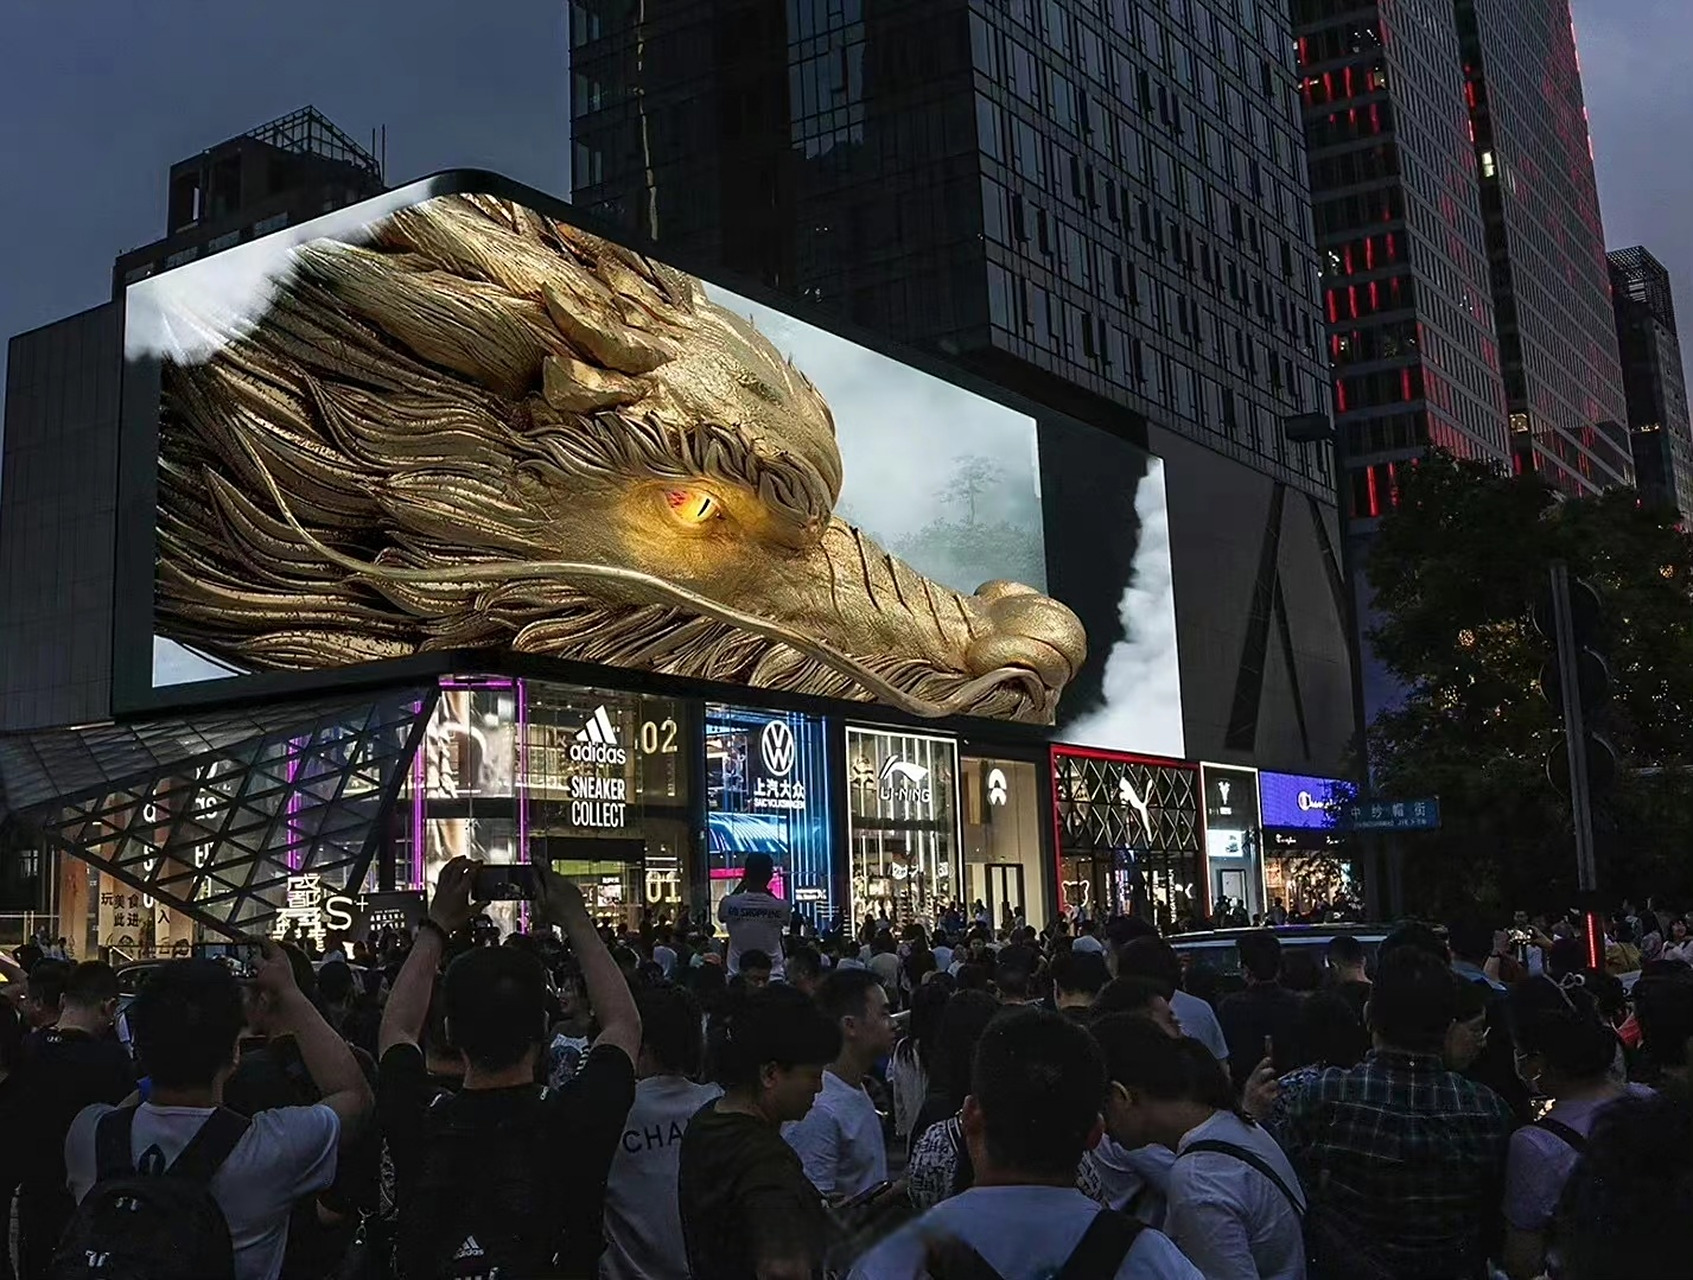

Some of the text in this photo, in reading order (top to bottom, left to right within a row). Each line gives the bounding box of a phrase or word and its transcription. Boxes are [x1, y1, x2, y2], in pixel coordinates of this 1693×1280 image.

[641, 719, 679, 754] 02
[570, 740, 626, 765] adidas
[571, 775, 625, 800] SNEAKER
[754, 777, 805, 798] 上汽大众
[571, 801, 626, 827] COLLECT
[645, 871, 681, 903] 01
